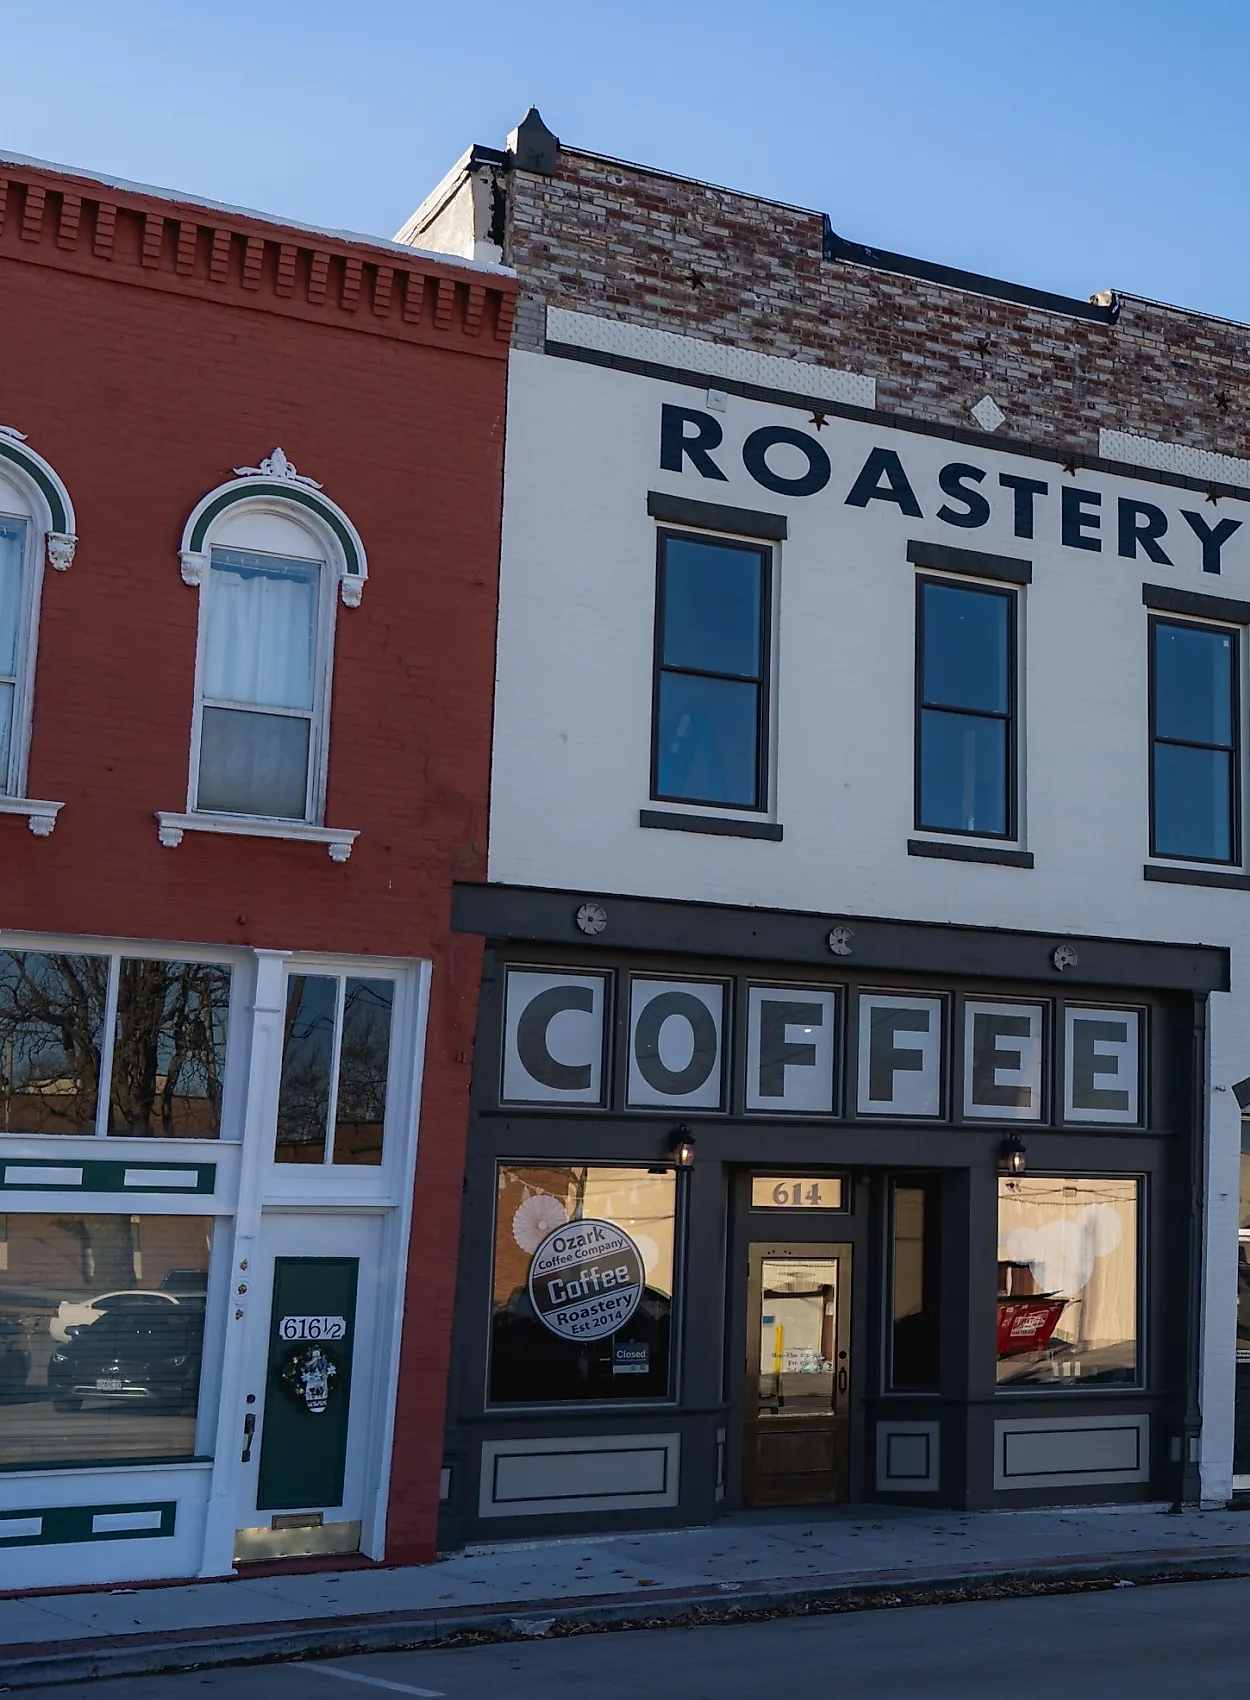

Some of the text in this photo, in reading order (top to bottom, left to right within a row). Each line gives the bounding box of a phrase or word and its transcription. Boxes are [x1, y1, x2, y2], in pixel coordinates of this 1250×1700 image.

[659, 402, 1244, 576] ROASTERY
[515, 985, 1131, 1111] COFFEE
[773, 1182, 822, 1206] 614
[538, 1238, 625, 1270] Coffee Company
[553, 1226, 606, 1253] Ozark
[547, 1266, 630, 1305] Coffee
[556, 1292, 633, 1326] Roastery
[571, 1310, 624, 1335] Est 2014
[616, 1350, 646, 1359] Closed
